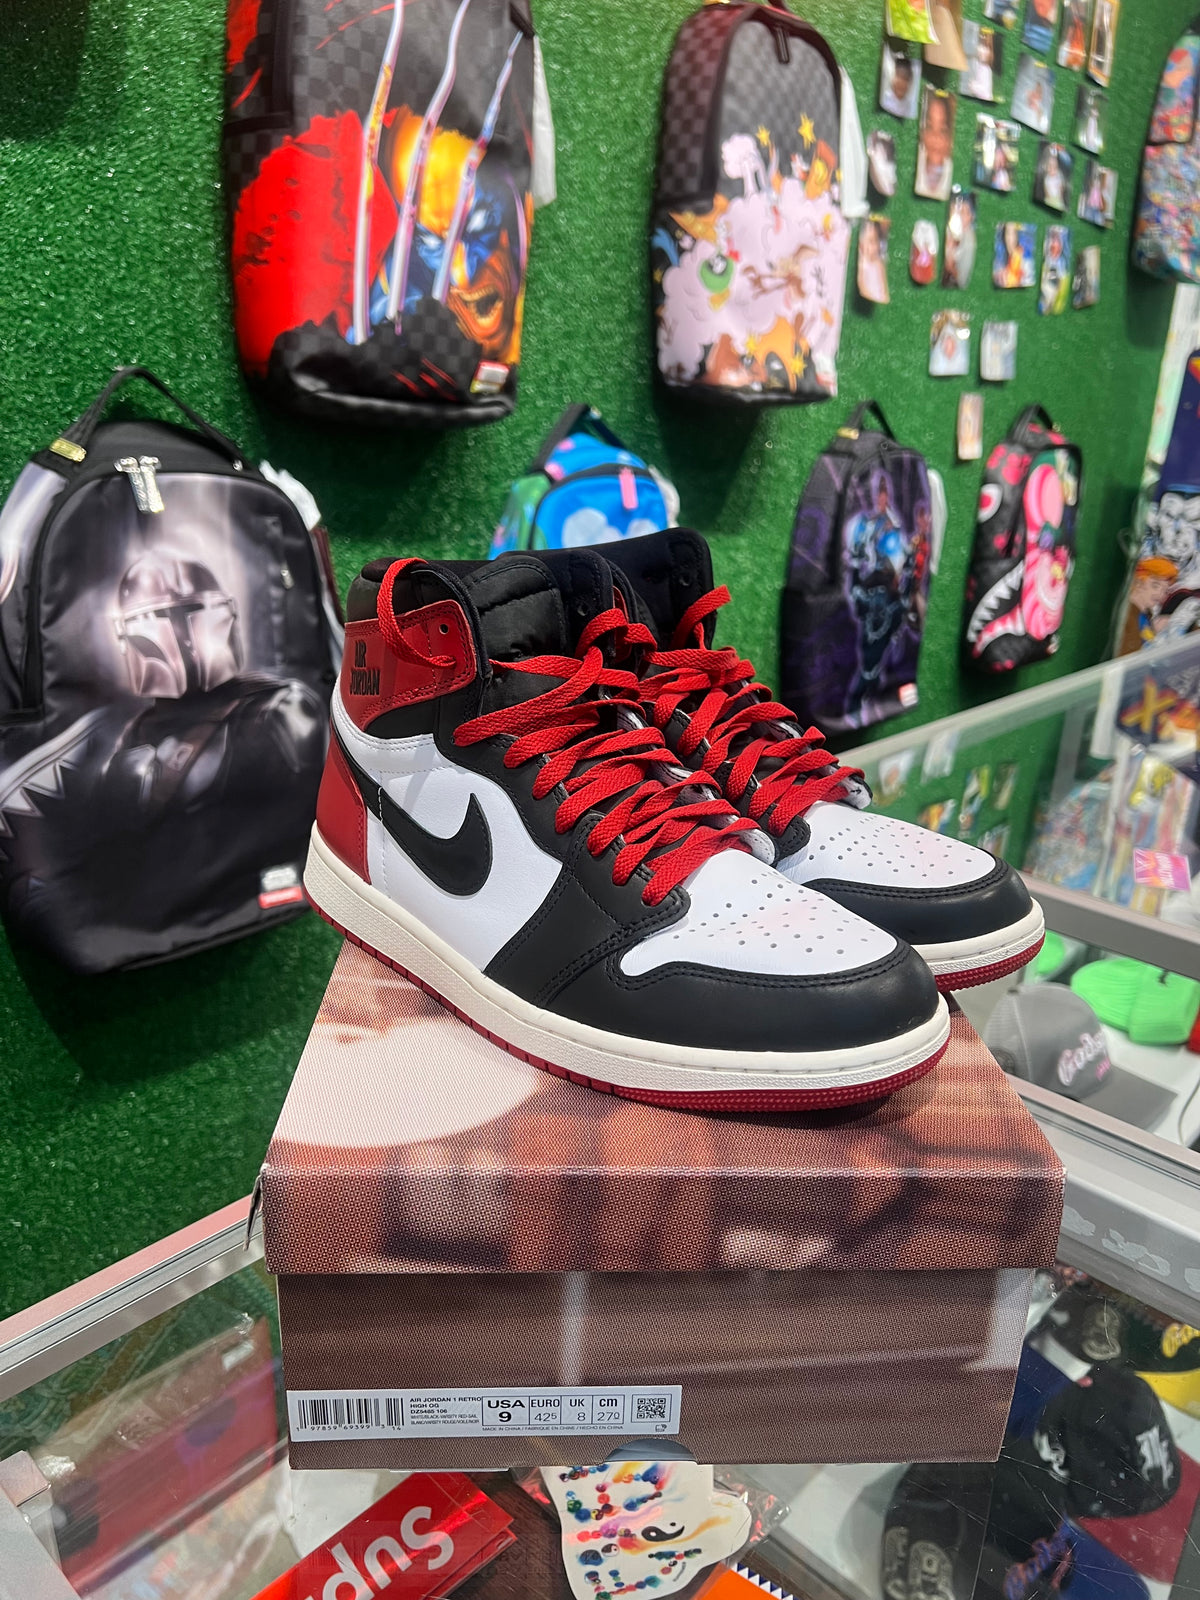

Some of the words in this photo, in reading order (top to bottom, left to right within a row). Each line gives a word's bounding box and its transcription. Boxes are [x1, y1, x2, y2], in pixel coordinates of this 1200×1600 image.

[349, 669, 381, 696] JORDAN
[487, 1399, 526, 1409] USA
[530, 1398, 560, 1408] EURO
[569, 1398, 585, 1407] UK
[599, 1398, 618, 1407] cm
[498, 1411, 512, 1423] 9
[577, 1412, 586, 1422] 8
[303, 1505, 454, 1600] Sup
